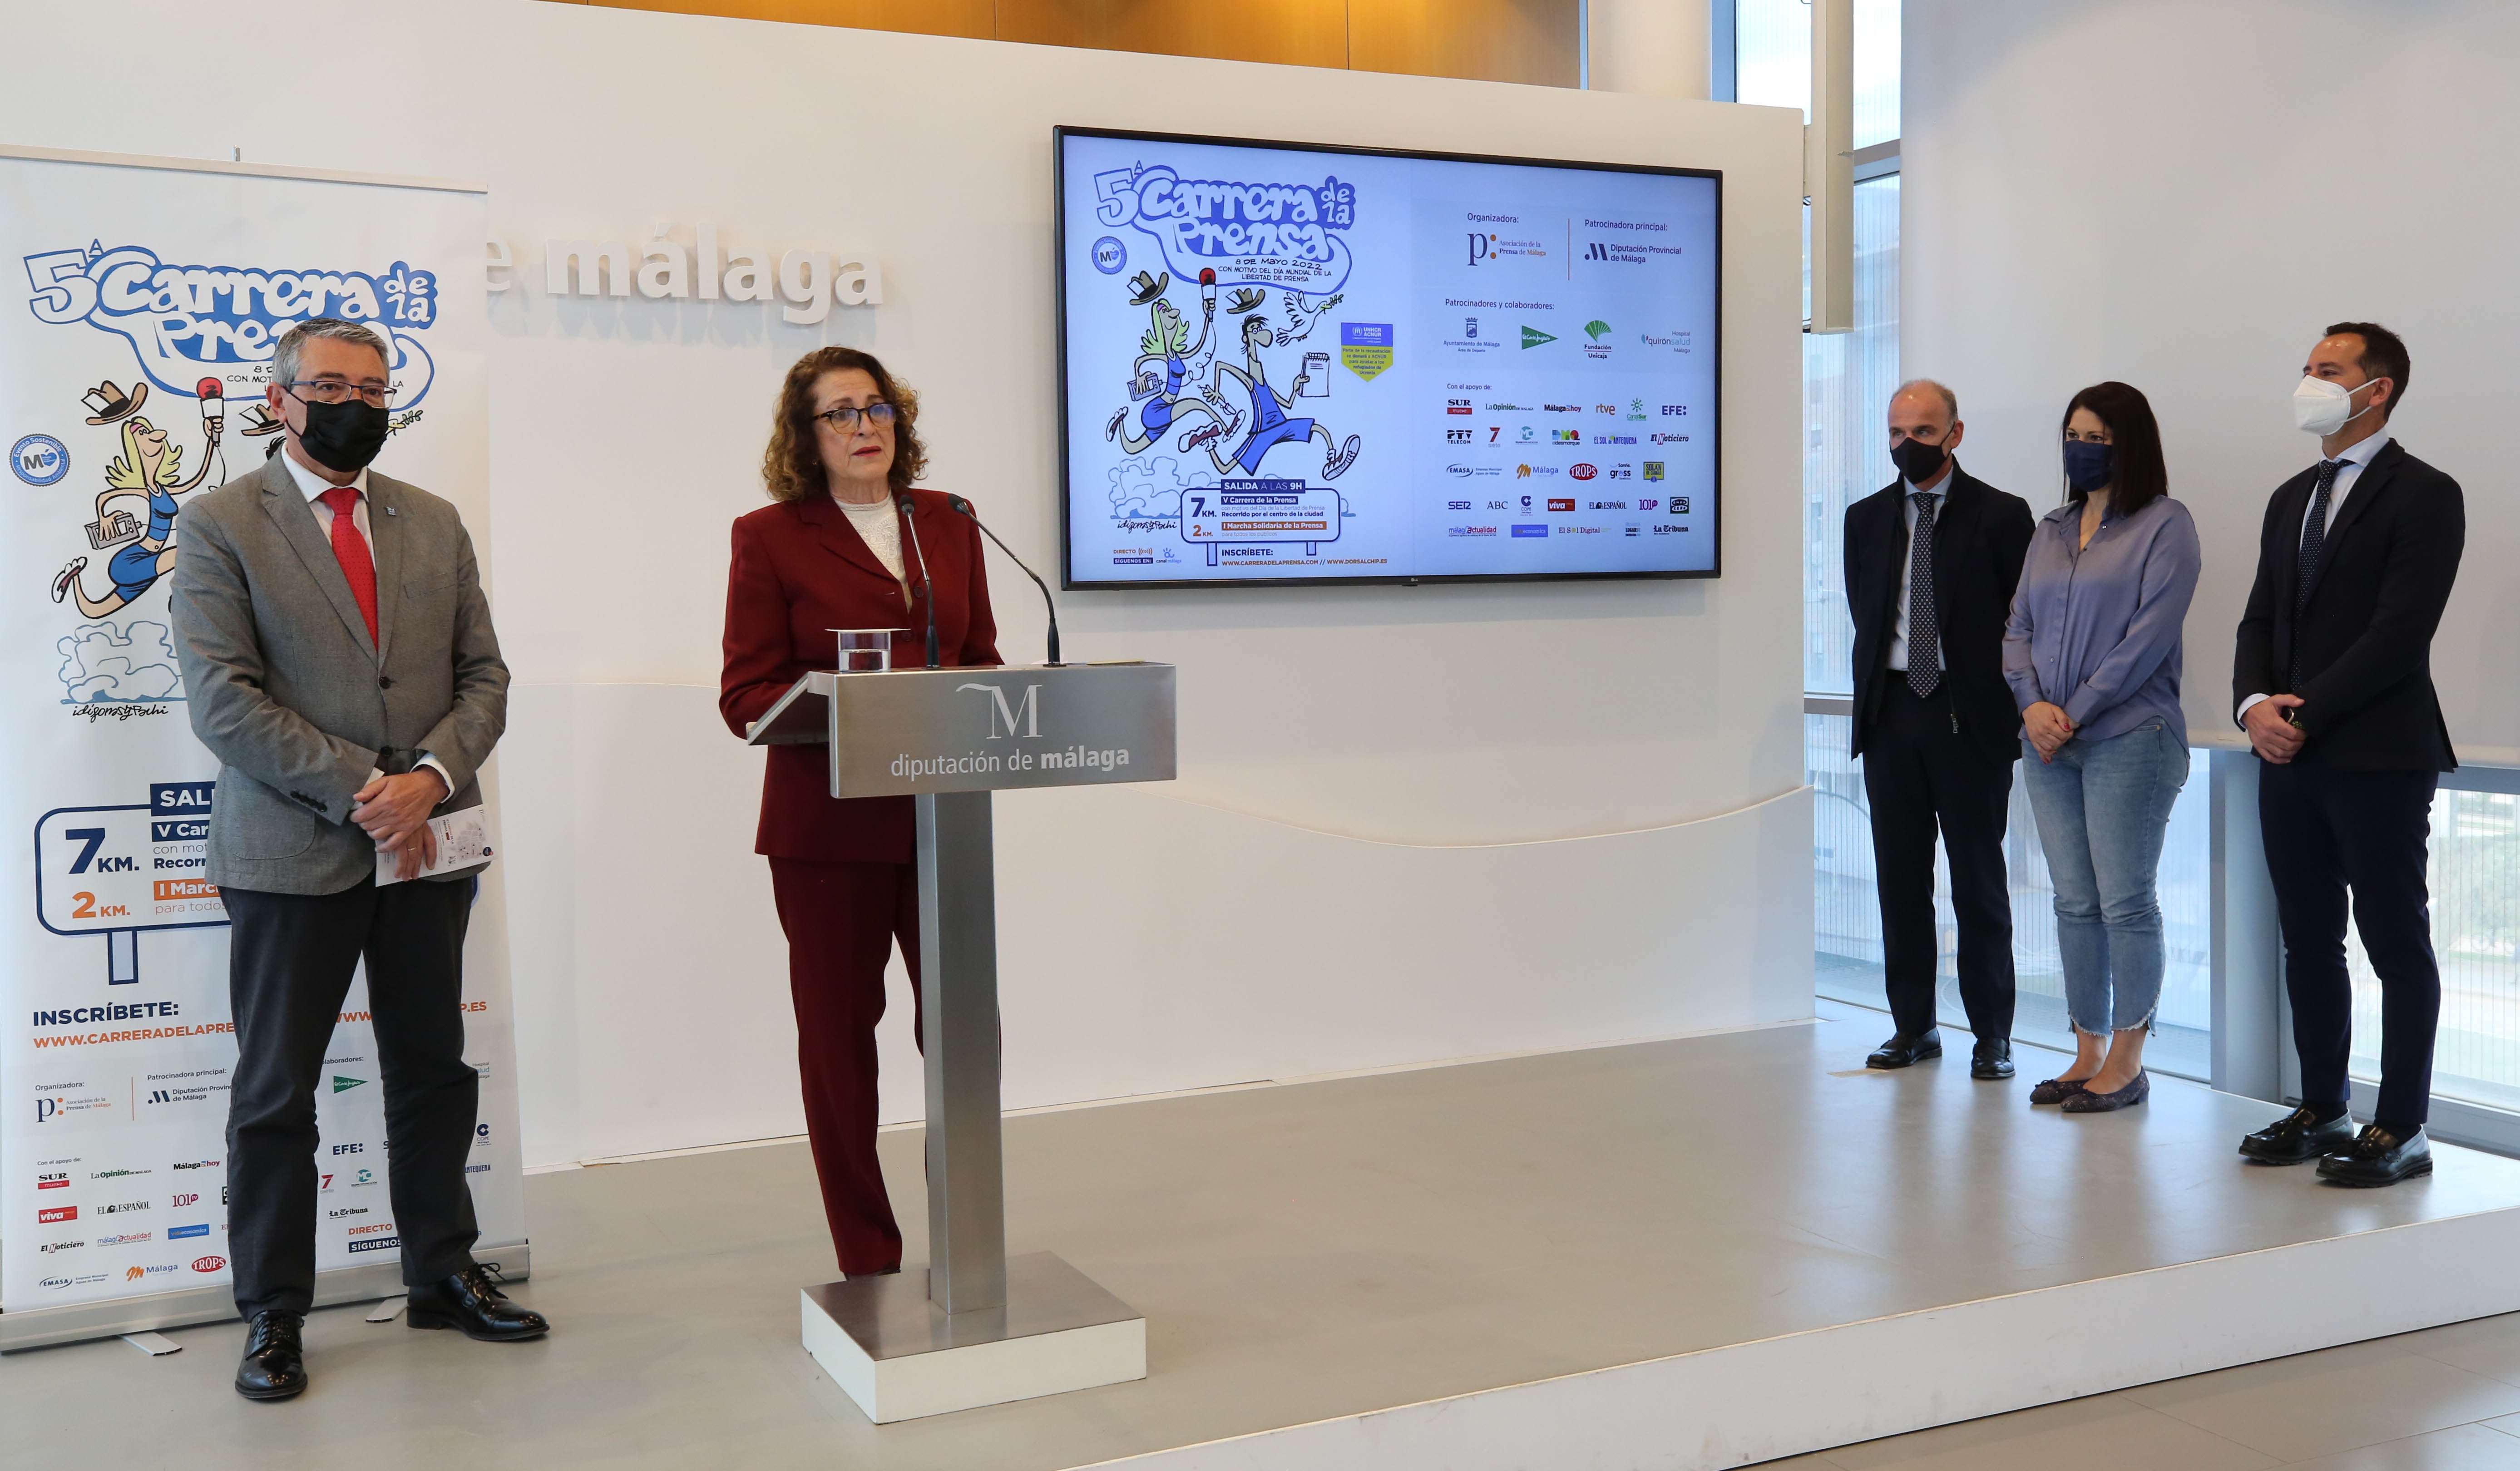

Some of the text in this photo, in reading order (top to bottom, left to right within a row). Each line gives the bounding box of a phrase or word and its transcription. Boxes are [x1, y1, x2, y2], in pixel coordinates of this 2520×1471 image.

[1140, 178, 1319, 222] Carrera
[1320, 183, 1350, 203] de
[1467, 212, 1519, 223] Organizadora:
[1585, 219, 1668, 232] Patrocinadora principal:
[1173, 219, 1329, 260] Prensa
[1611, 244, 1681, 255] Diputación Provincial
[1292, 260, 1322, 270] 2022
[1621, 254, 1646, 264] Málaga
[546, 222, 883, 325] málaga
[98, 258, 379, 318] Carrera
[383, 269, 428, 295] de
[1445, 298, 1497, 308] Patrocinadores
[1505, 301, 1554, 310] colaboradores:
[1596, 403, 1615, 415] rtve
[1657, 433, 1689, 445] Noticiero
[14, 437, 62, 457] Evento Sostenible
[52, 459, 66, 478] Ambiental
[1533, 466, 1558, 475] Málaga
[1570, 464, 1597, 478] TROPS
[1191, 498, 1205, 517] 7
[1448, 501, 1471, 509] SER
[1487, 501, 1508, 509] ABC
[1604, 500, 1627, 509] ESPAÑOL
[1193, 525, 1201, 537] 2
[1221, 547, 1273, 557] INSCRÍBETE:
[891, 745, 1130, 781] diputación de málaga
[157, 825, 171, 837] V
[65, 828, 139, 874] 7 KM.
[153, 844, 178, 854] con
[72, 891, 130, 918] 2 KM.
[155, 902, 185, 915] para
[33, 1002, 178, 1026] INSCRÍBETE:
[147, 1068, 227, 1081] Patrocinadora principal:
[35, 1081, 84, 1091] Organizadora:
[173, 1086, 208, 1096] Diputación
[183, 1093, 207, 1102] Málaga
[173, 1161, 201, 1170] Málaga
[39, 1172, 68, 1181] SUR
[98, 1201, 150, 1214] EL ESPAÑOL
[340, 1207, 368, 1216] Tribuna
[40, 1211, 64, 1221] viva
[349, 1224, 392, 1235] DIRECTO
[48, 1241, 84, 1253] Noticiero
[146, 1264, 178, 1274] Málaga
[193, 1257, 225, 1270] TROPS
[44, 1278, 69, 1286] EMASA
